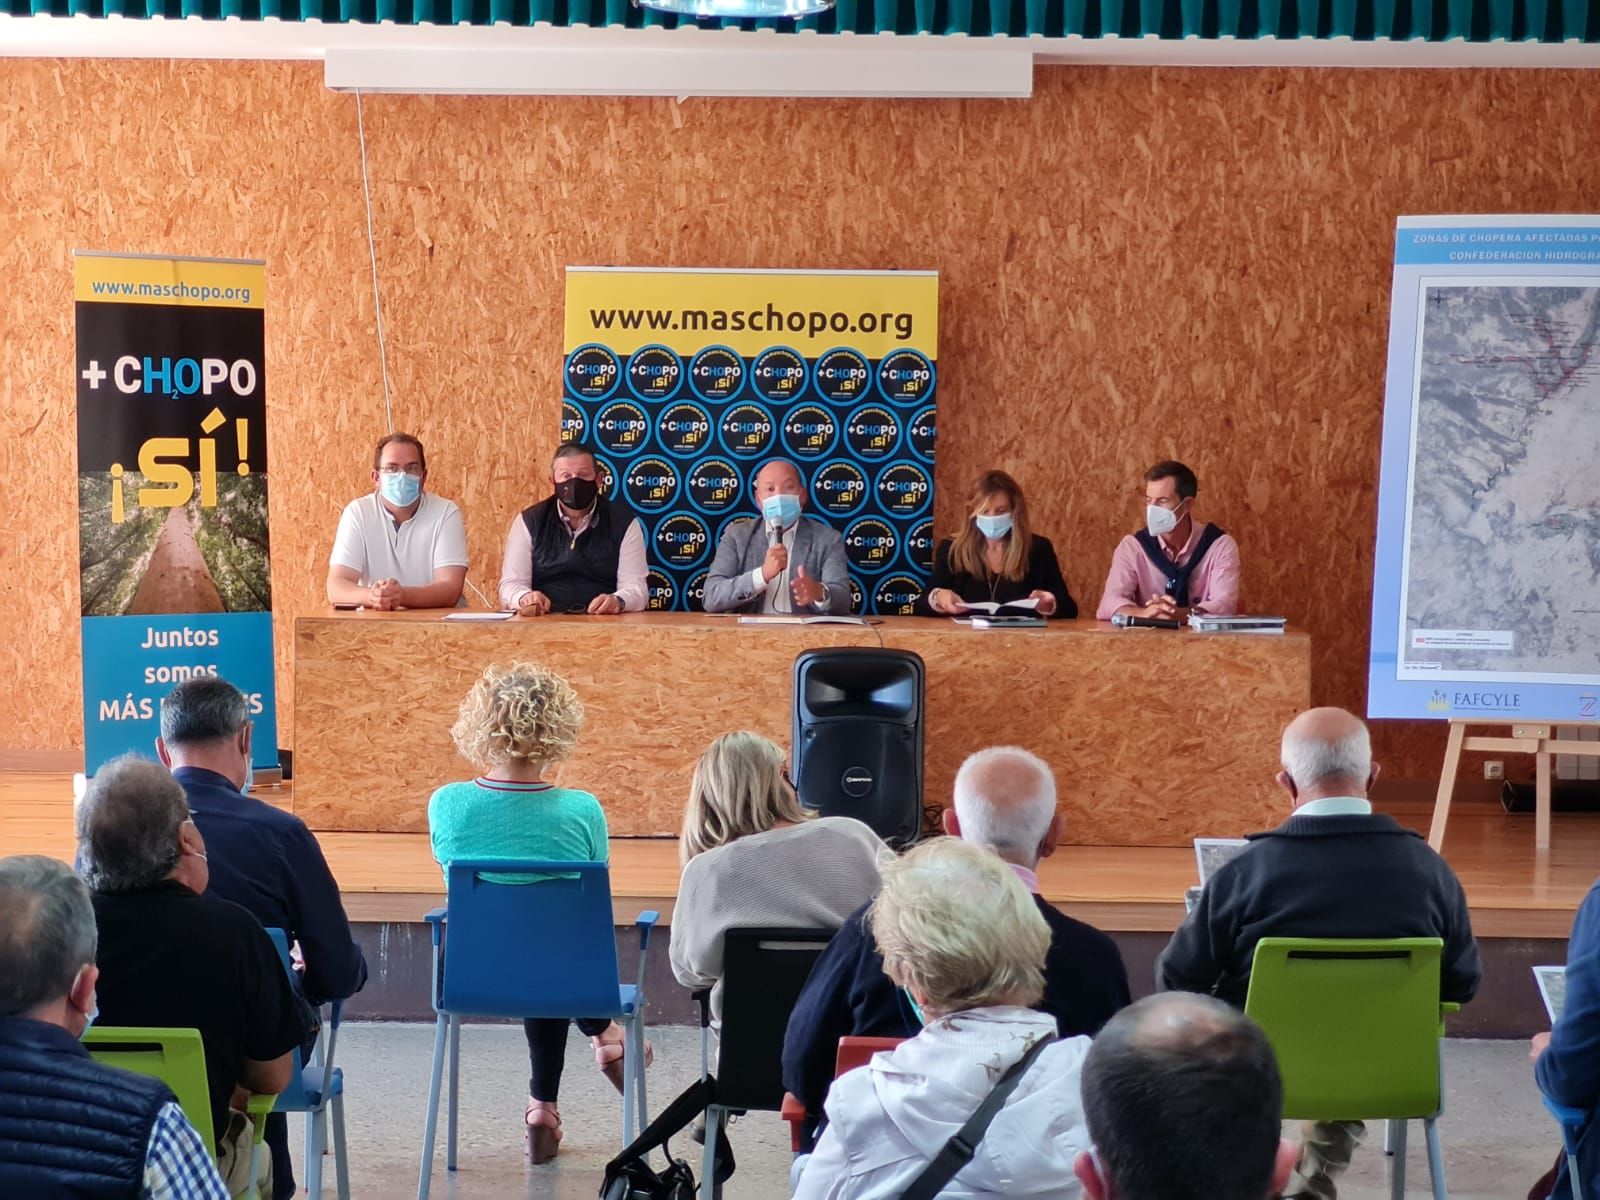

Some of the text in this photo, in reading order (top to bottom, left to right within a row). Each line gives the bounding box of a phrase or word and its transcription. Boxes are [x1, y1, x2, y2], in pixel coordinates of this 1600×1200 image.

[1413, 233, 1449, 244] ZONAS
[1451, 233, 1466, 243] DE
[1470, 233, 1521, 243] CHOPERA
[1525, 233, 1587, 242] AFECTADAS
[92, 281, 250, 303] www.maschopo.org
[589, 303, 913, 340] www.maschopo.org
[111, 407, 250, 523] ¡SÍ!
[141, 627, 219, 648] Juntos
[145, 664, 217, 683] somos
[100, 692, 154, 721] MÁS
[1453, 692, 1520, 707] FAFCYLE
